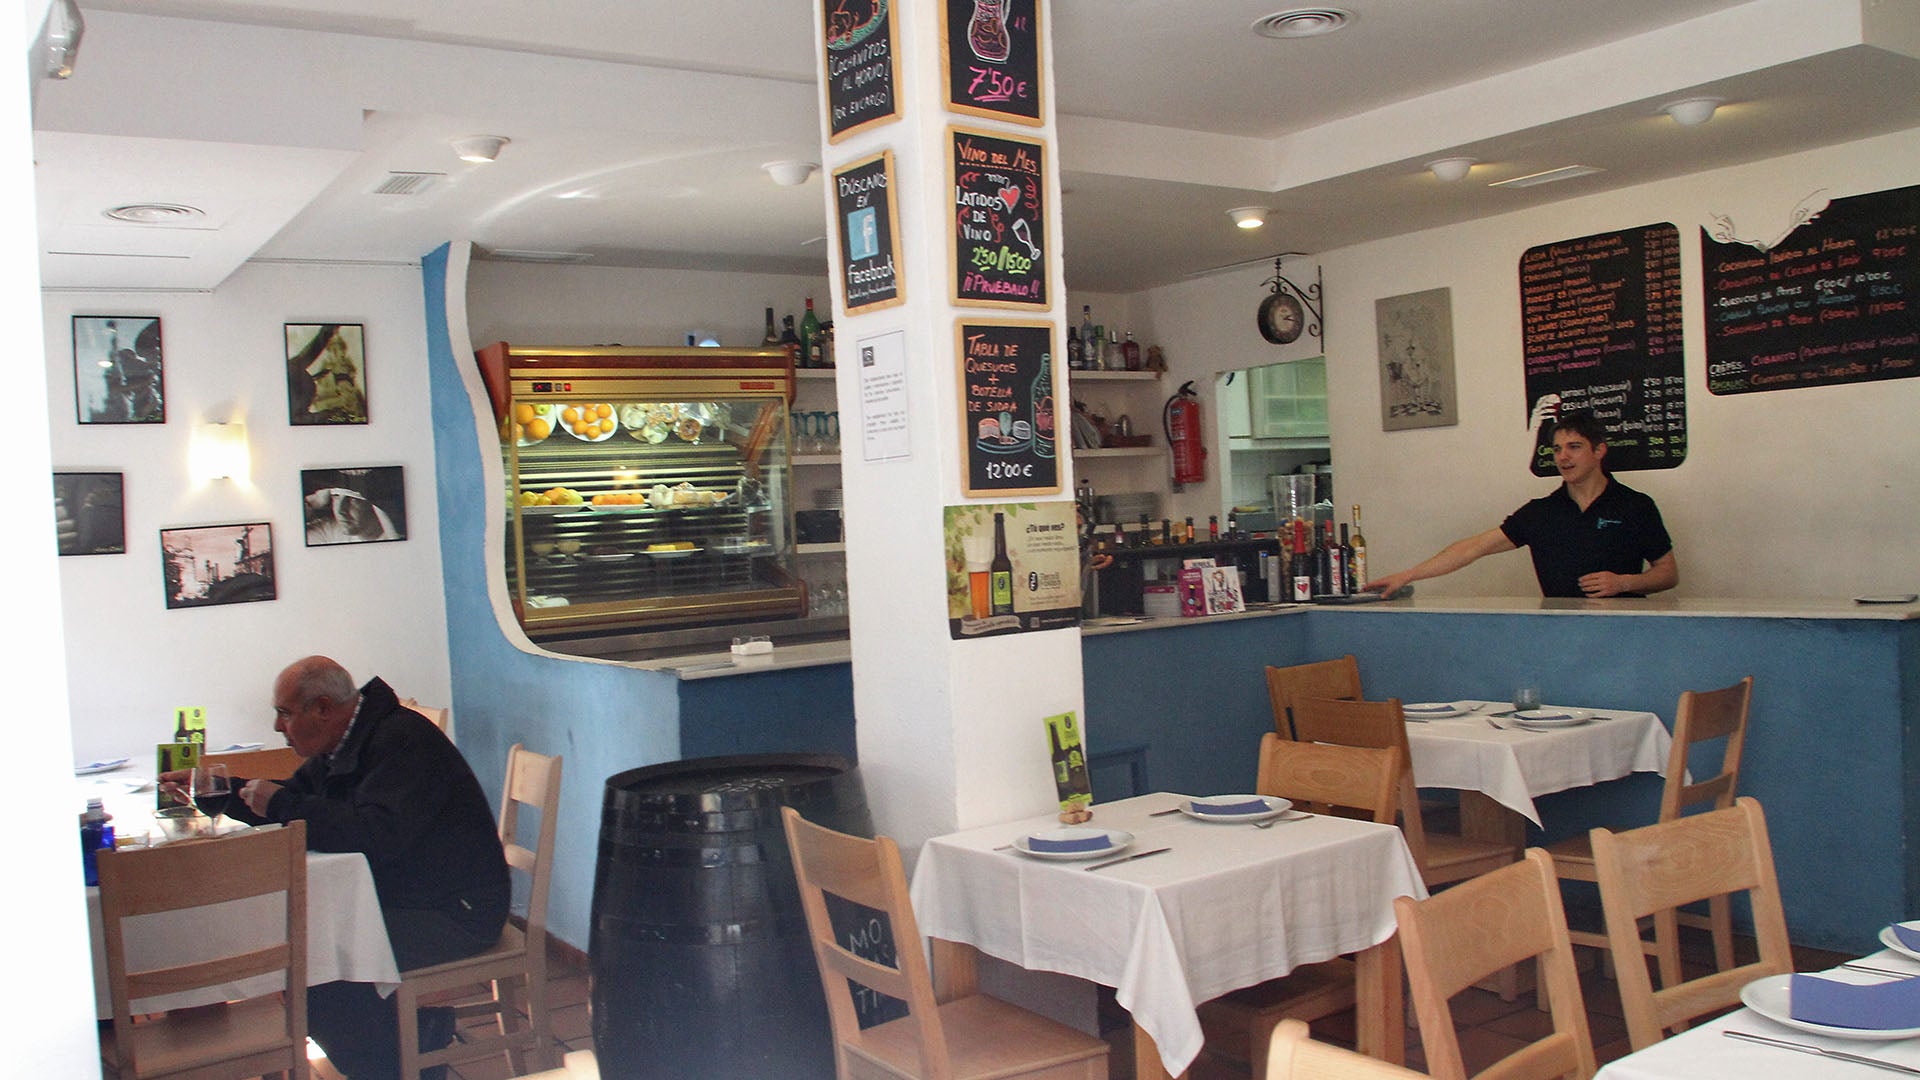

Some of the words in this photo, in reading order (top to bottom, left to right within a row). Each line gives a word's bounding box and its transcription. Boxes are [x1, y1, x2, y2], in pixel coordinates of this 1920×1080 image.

[957, 139, 987, 163] VINO
[991, 153, 1008, 165] DEL
[1013, 148, 1037, 172] MES
[956, 186, 1002, 210] LATIDOS
[972, 210, 987, 223] DE
[963, 224, 993, 242] VINO
[848, 254, 896, 284] facebook
[967, 333, 999, 357] TABLA
[1003, 344, 1019, 357] DE
[965, 357, 1018, 374] QUESUCOS
[971, 384, 1013, 398] BOTELLA
[968, 400, 981, 412] DE
[986, 400, 1018, 413] SIDRA
